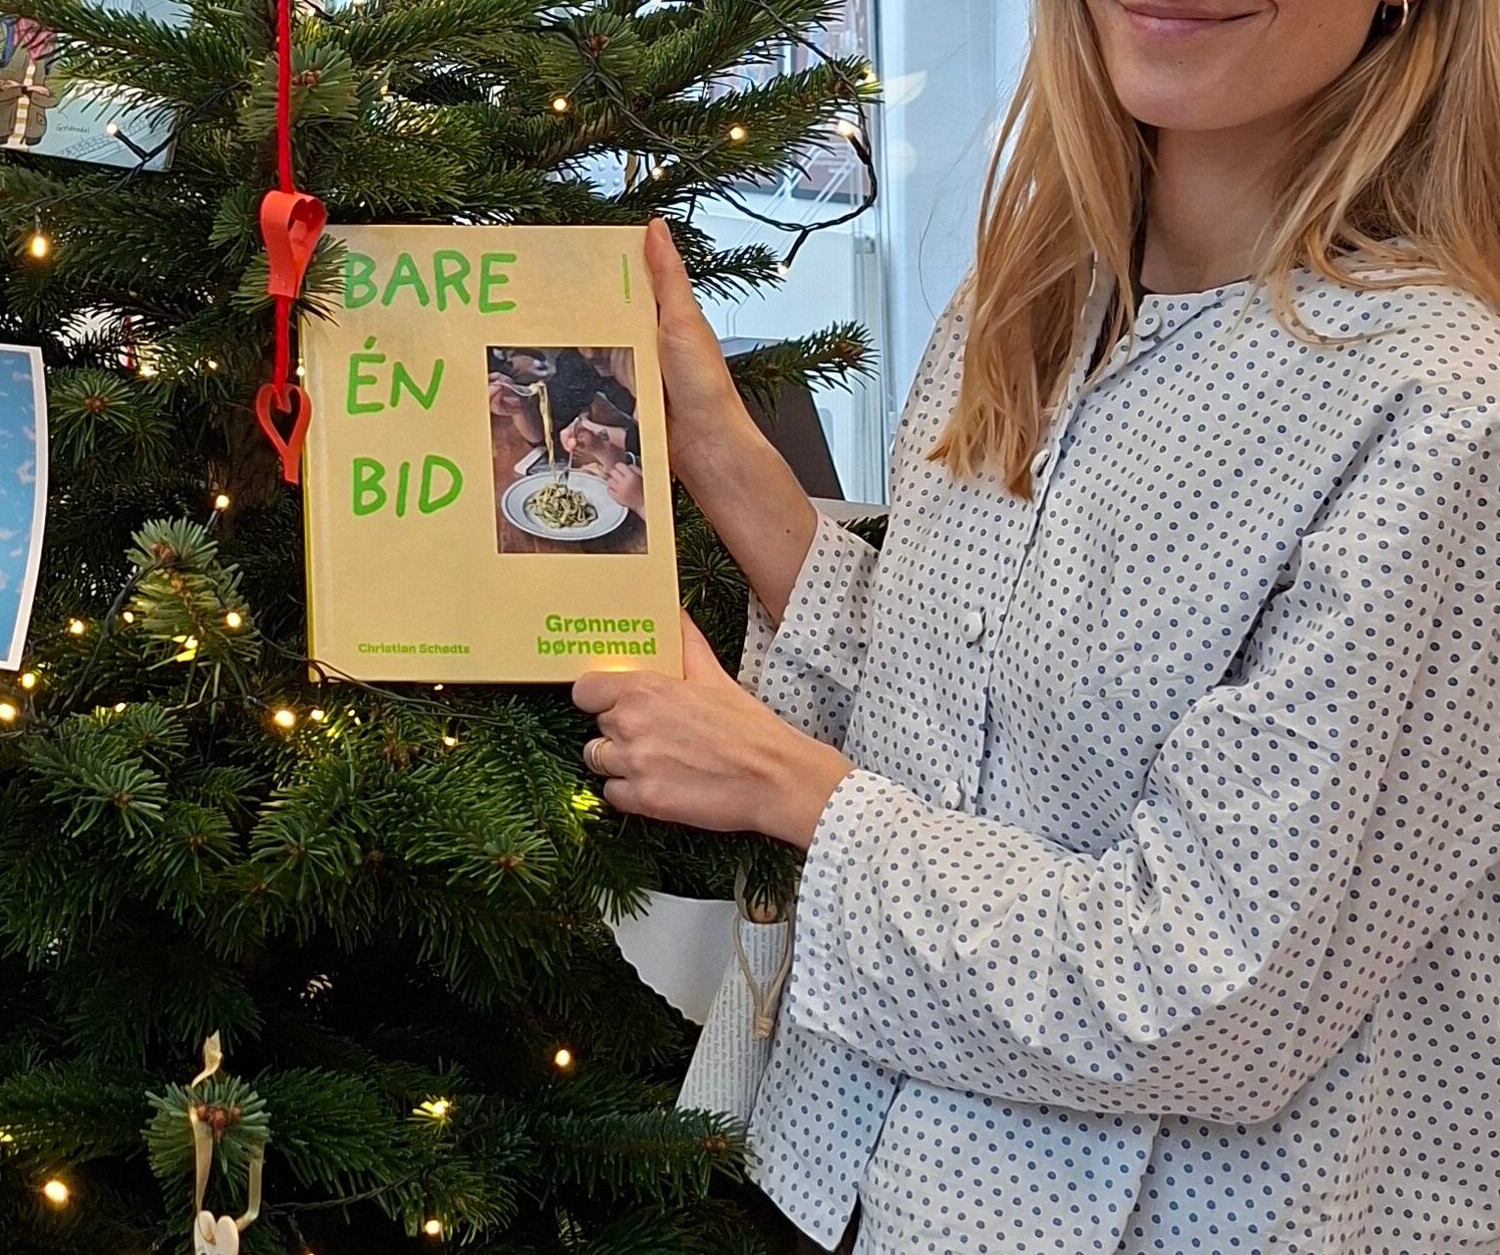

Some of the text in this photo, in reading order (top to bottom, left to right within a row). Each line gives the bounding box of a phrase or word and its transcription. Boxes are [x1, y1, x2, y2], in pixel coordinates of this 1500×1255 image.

[343, 250, 517, 314] BARE
[346, 335, 445, 415] ÉN
[352, 454, 463, 517] BID
[545, 614, 655, 635] Grønnere
[357, 642, 416, 654] Christian
[537, 636, 657, 656] børnemad
